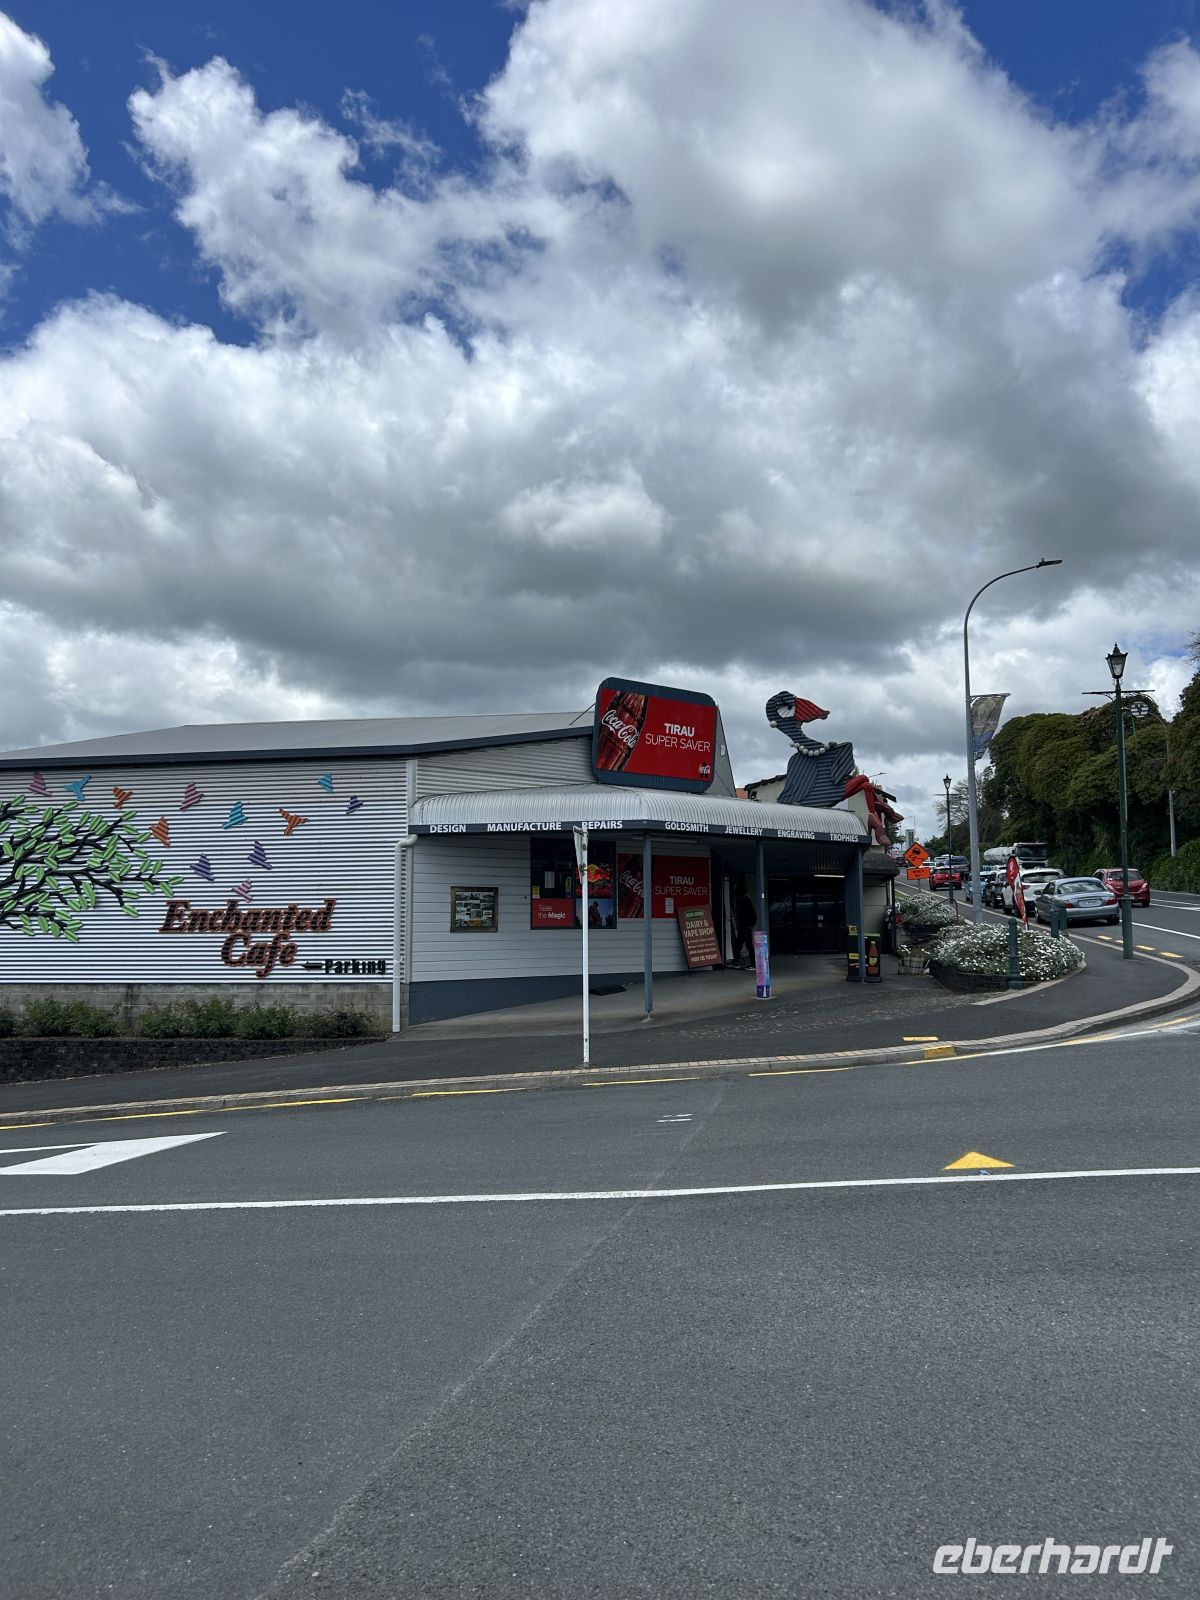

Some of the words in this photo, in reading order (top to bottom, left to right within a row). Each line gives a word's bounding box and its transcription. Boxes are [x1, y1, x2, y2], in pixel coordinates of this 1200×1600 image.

[664, 723, 695, 737] TIRAU
[645, 733, 678, 748] SUPER
[679, 738, 711, 752] SAVER
[429, 824, 467, 834] DESIGN
[487, 821, 562, 832] MANUFACTURE
[581, 820, 623, 830] REPAIRS
[665, 821, 709, 833] GOLDSMITH
[724, 825, 763, 837] JEWELLERY
[777, 829, 815, 840] ENGRAVING
[829, 833, 859, 843] TROPHIES
[619, 870, 645, 898] Coca-Co
[669, 875, 694, 886] TIRAU
[655, 886, 681, 895] SUPER
[682, 886, 708, 896] SAVER
[537, 904, 553, 912] Taste
[158, 898, 337, 934] Enchanted
[547, 911, 566, 920] Magic
[685, 920, 703, 930] DAIRY
[683, 929, 699, 938] VAPE
[699, 927, 714, 936] SHOP
[221, 931, 298, 979] Cafe
[324, 959, 386, 975] Parking
